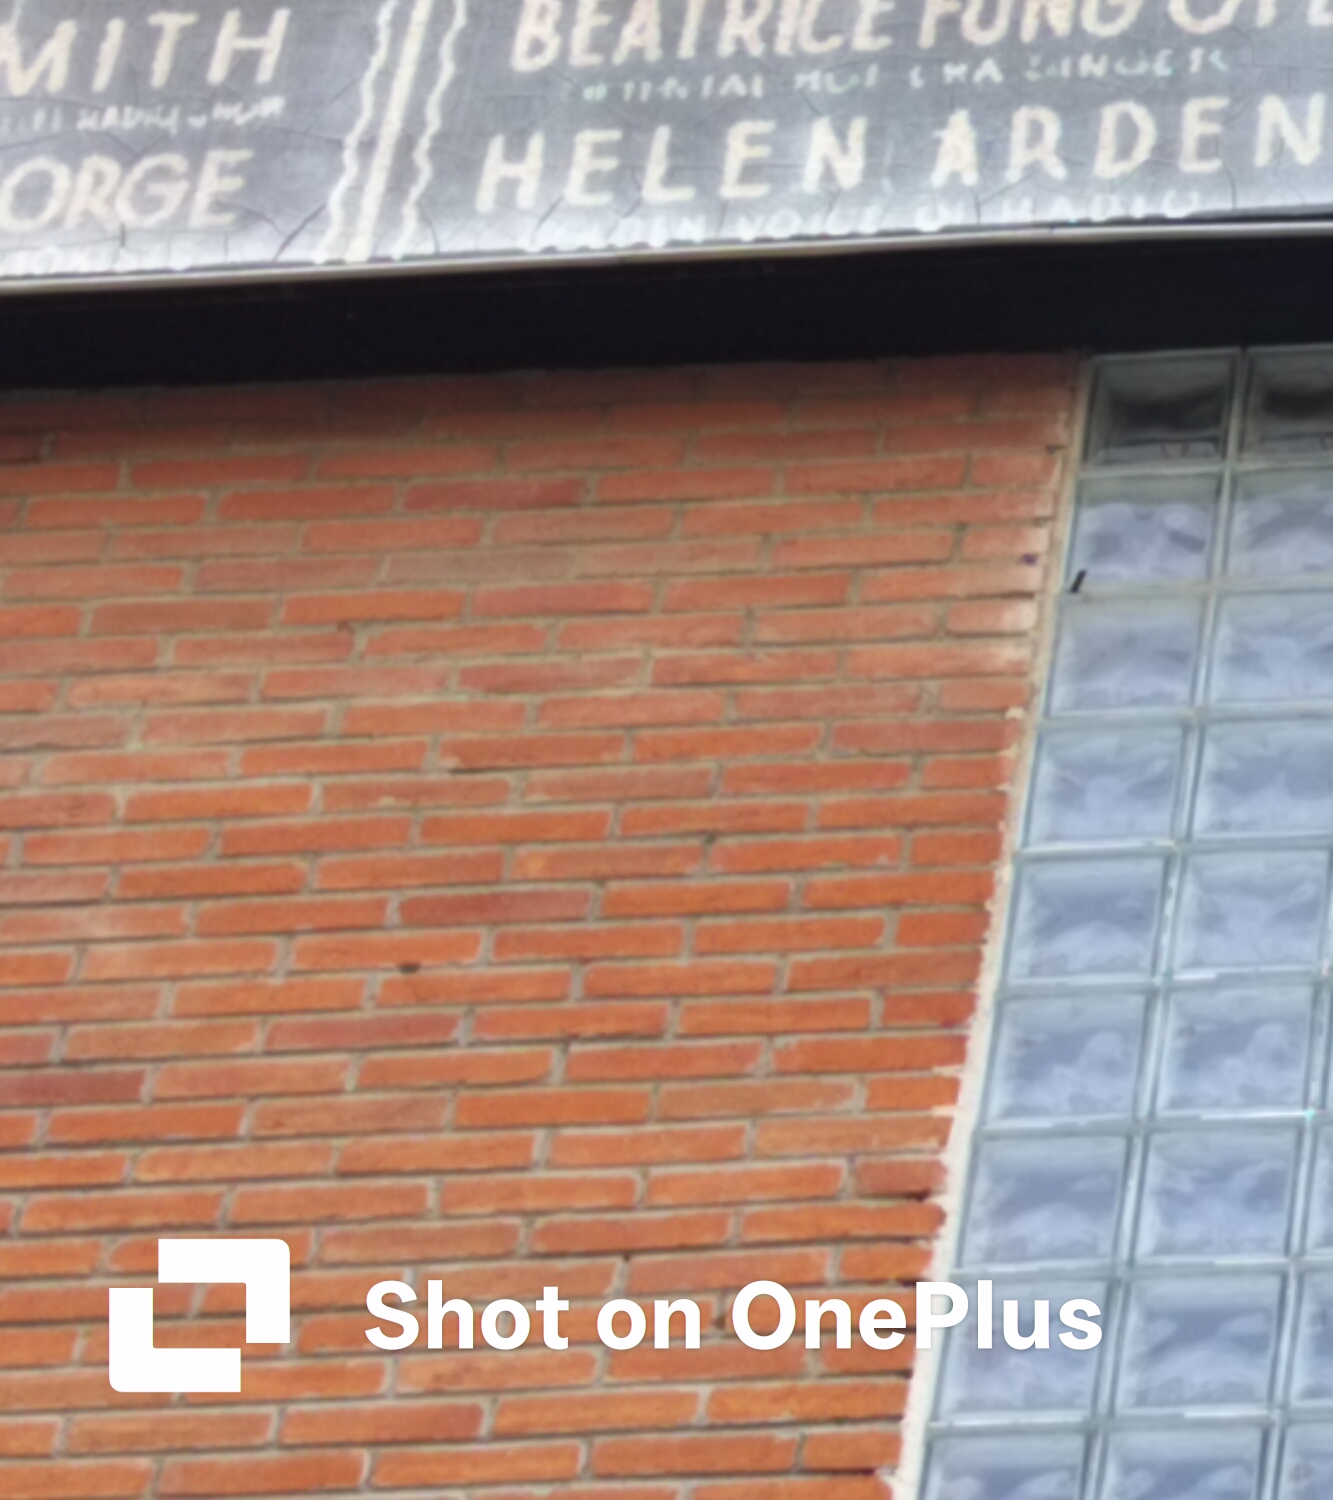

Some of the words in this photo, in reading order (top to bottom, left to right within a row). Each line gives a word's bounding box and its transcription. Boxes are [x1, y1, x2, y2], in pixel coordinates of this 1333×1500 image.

[0, 147, 253, 235] ORGE
[476, 116, 867, 213] HELEN
[931, 93, 1326, 189] ARDEN
